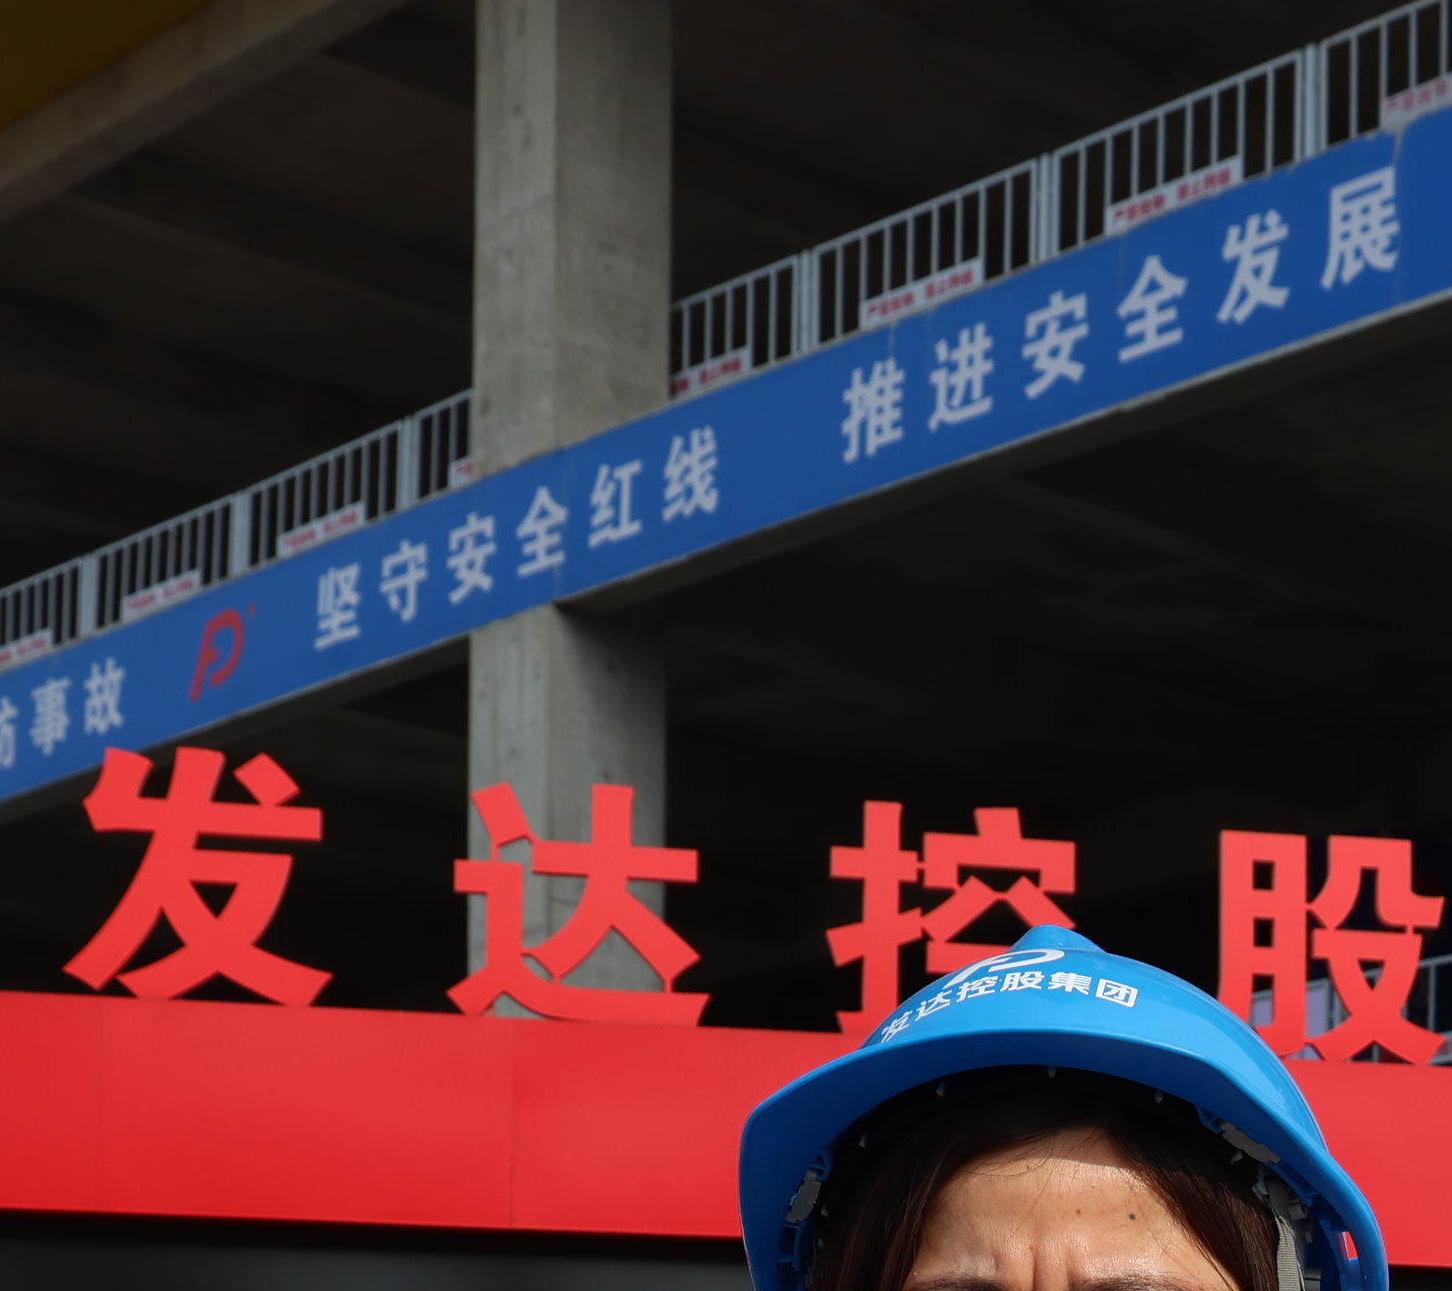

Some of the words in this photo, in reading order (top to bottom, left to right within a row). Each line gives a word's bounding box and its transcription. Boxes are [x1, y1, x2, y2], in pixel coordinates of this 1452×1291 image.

[842, 165, 1401, 463] 推进安全发展
[314, 426, 720, 649] 坚守安全红线
[880, 971, 1138, 1043] 发达控股集团
